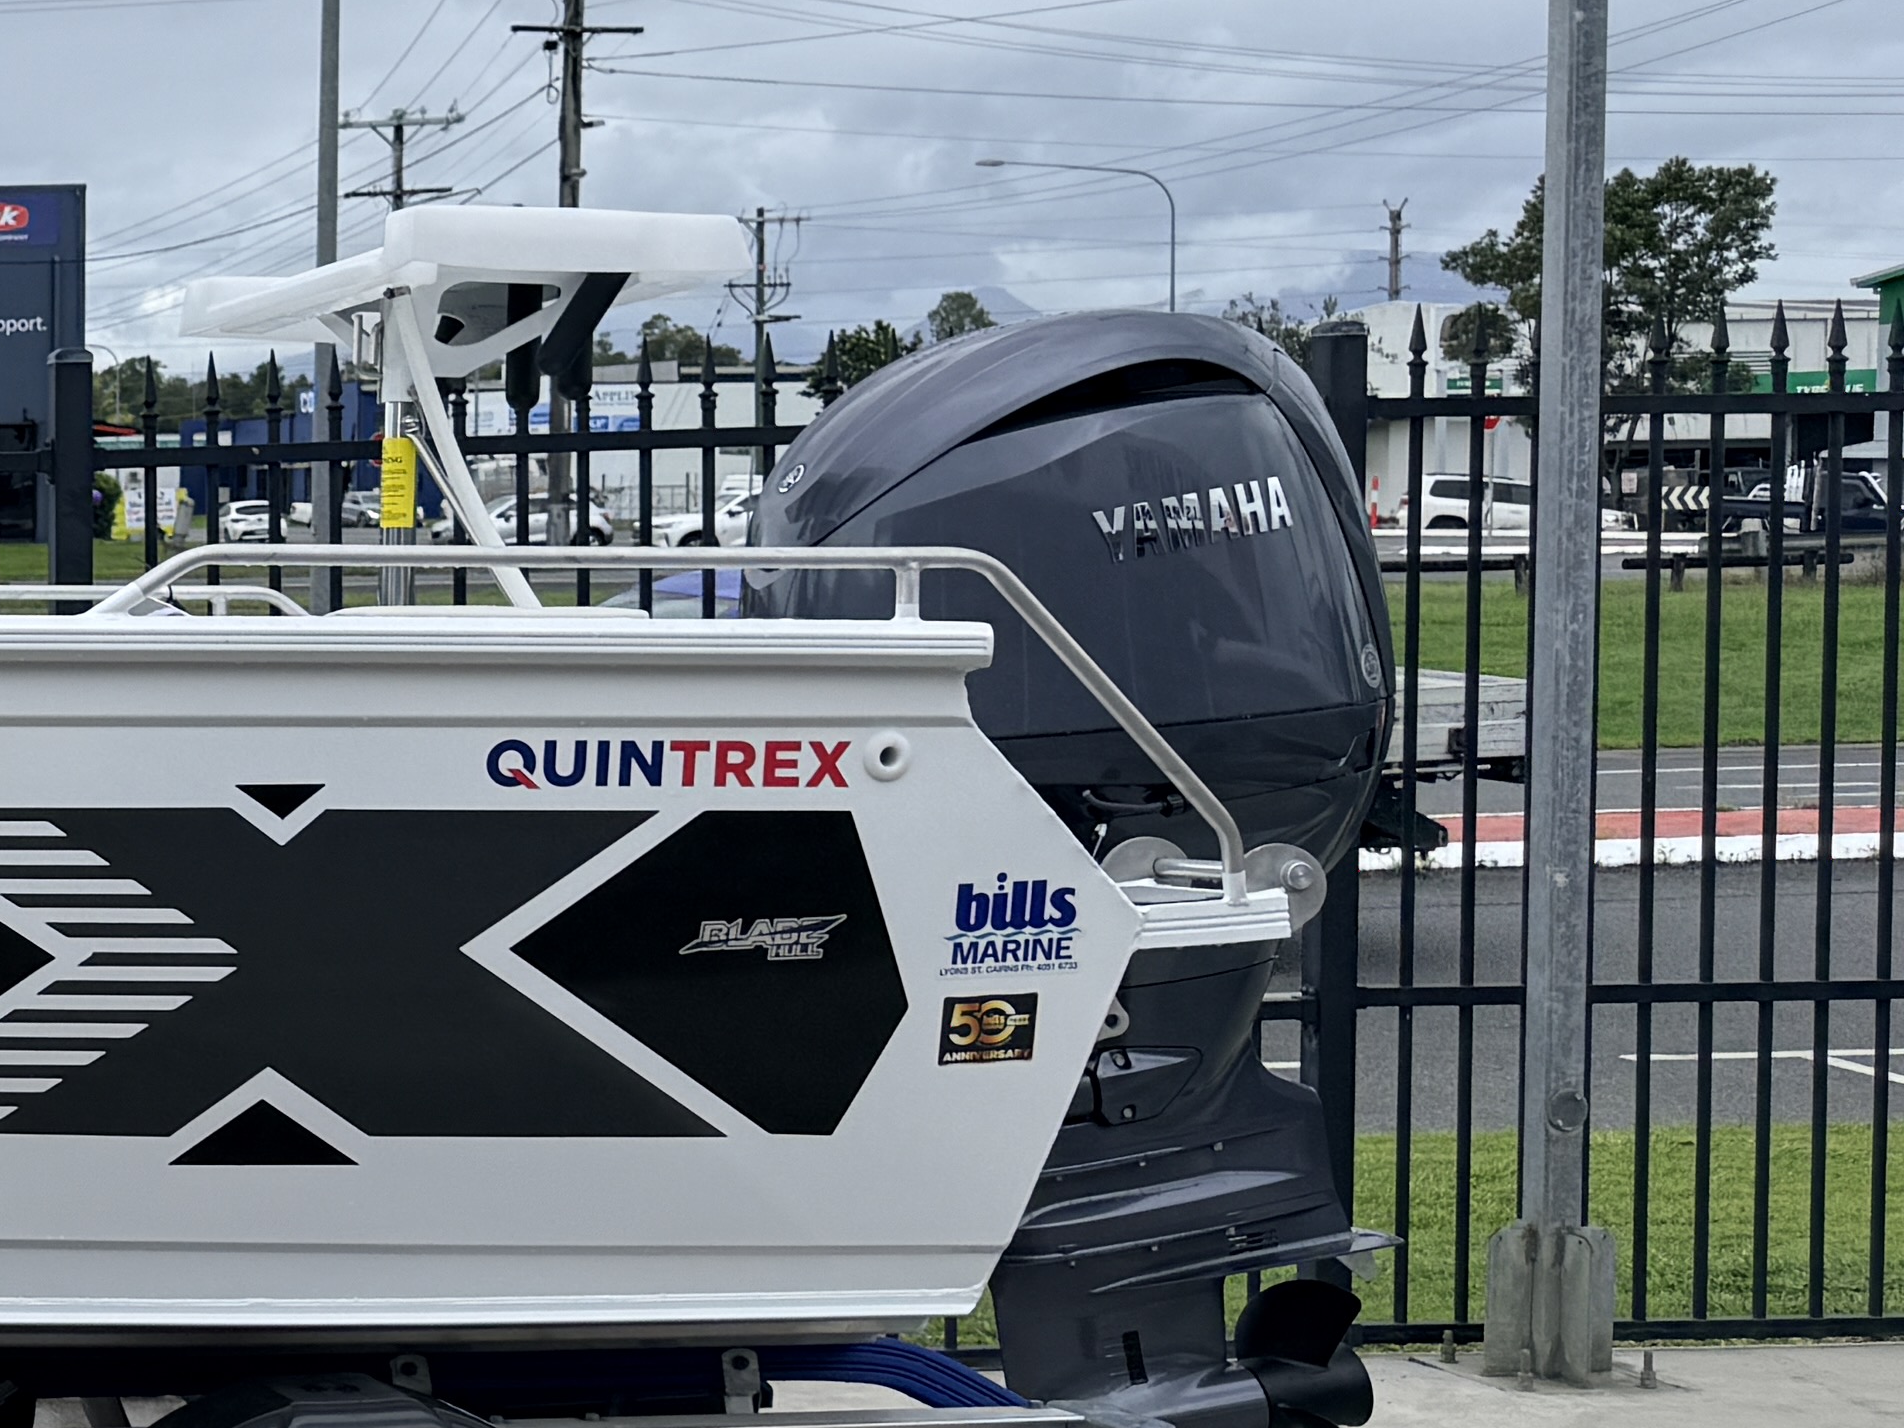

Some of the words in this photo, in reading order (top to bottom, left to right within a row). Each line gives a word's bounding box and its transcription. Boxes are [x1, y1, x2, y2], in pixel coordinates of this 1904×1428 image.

[1092, 476, 1293, 566] YAMAHA
[486, 739, 852, 790] QUINTREX
[955, 872, 1077, 933] bills
[695, 917, 837, 949] BLADE
[769, 943, 821, 958] HULL
[951, 936, 1073, 966] MARINE
[948, 1000, 1016, 1046] 50
[942, 1048, 1032, 1063] ANNIVERSARY
